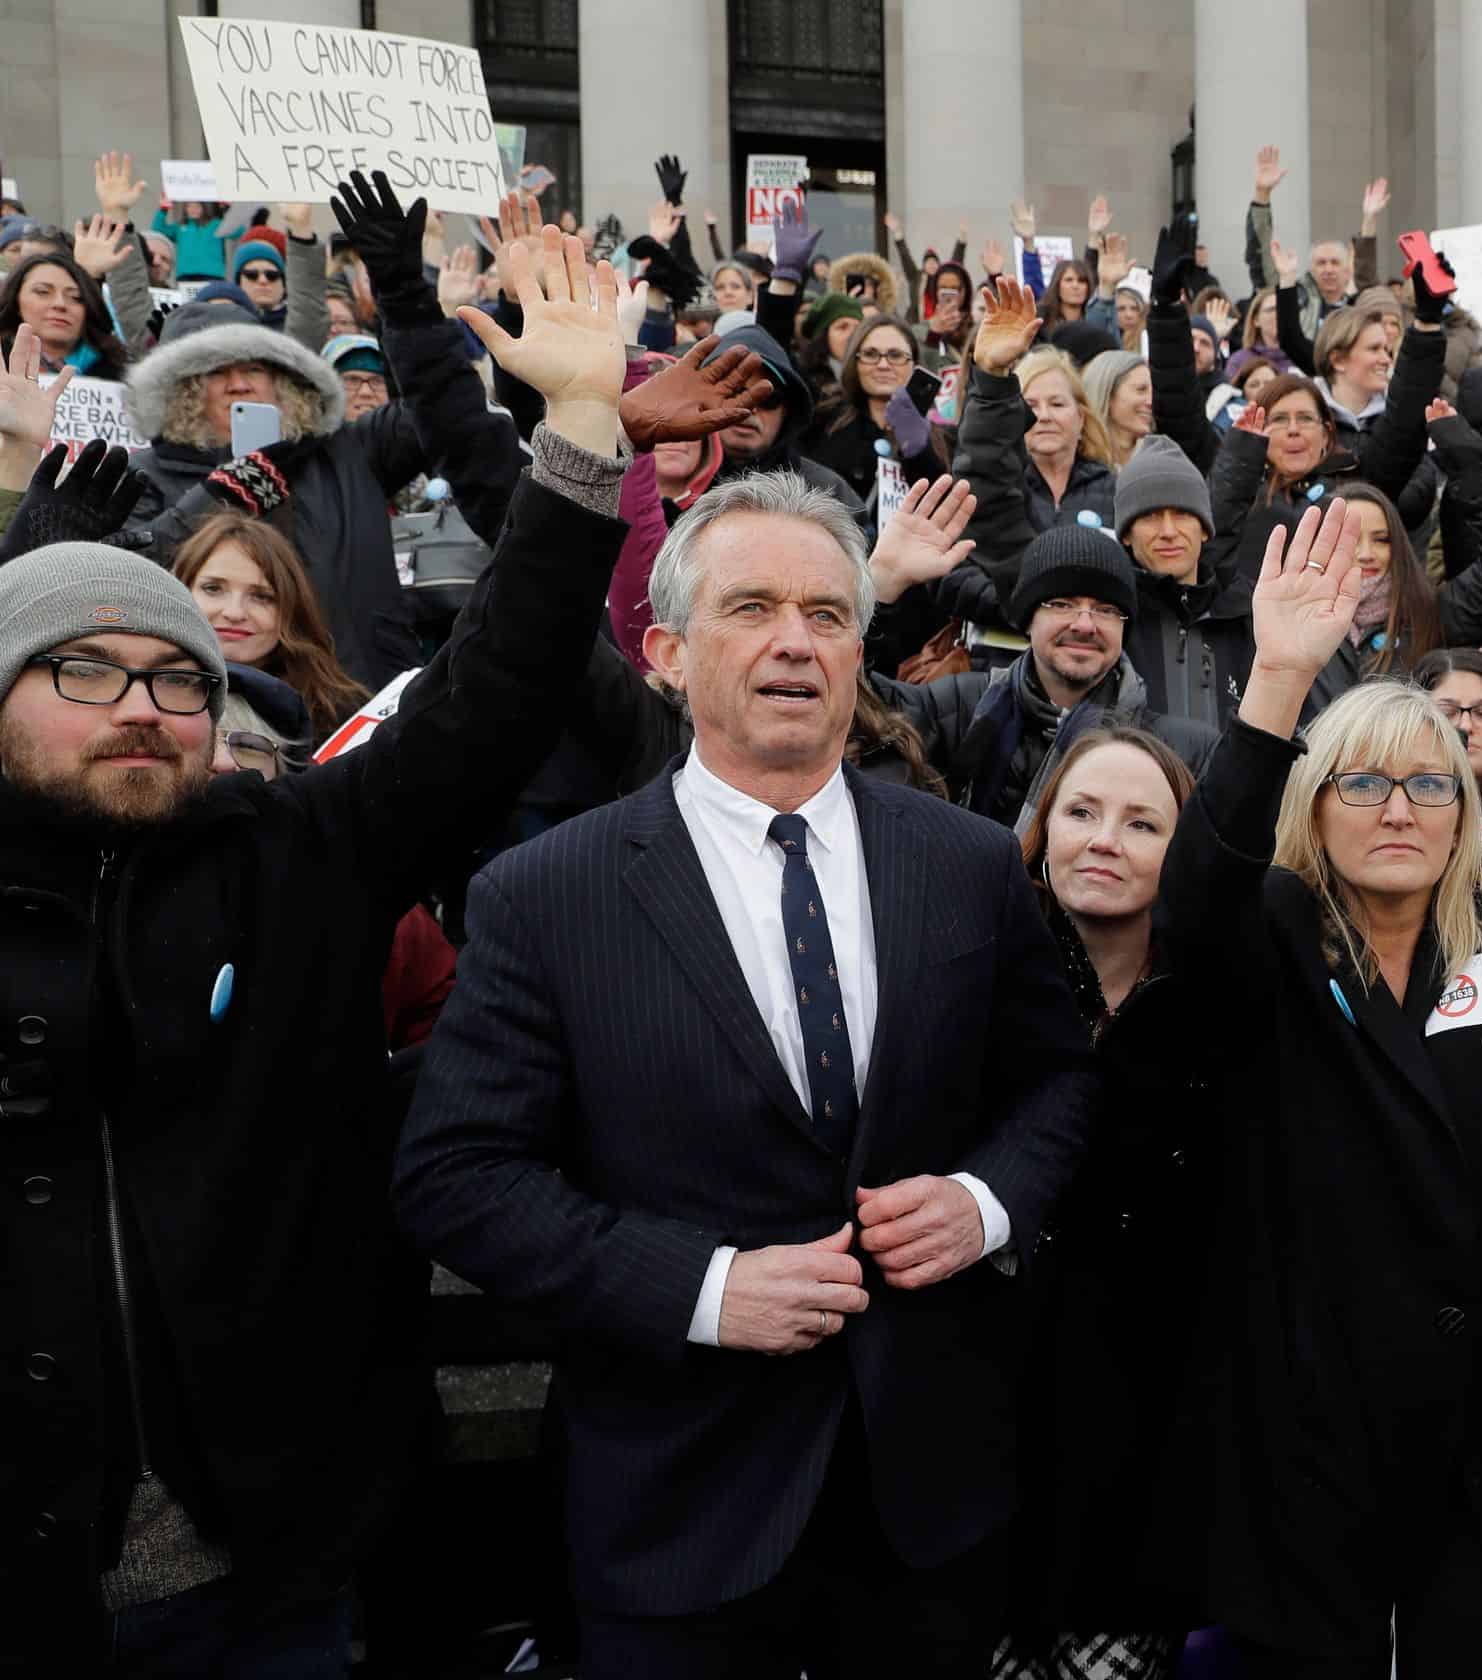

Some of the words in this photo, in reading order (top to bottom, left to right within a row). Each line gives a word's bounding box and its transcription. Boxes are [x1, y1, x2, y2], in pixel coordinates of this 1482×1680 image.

[190, 22, 273, 73] YOU
[294, 29, 408, 79] CANNOT
[417, 45, 485, 97] FORCE
[217, 82, 393, 138] VACCINES
[409, 100, 493, 144] INTO
[233, 143, 269, 192] A
[386, 150, 501, 197] SOCIETY
[1452, 987, 1474, 1000] 1638
